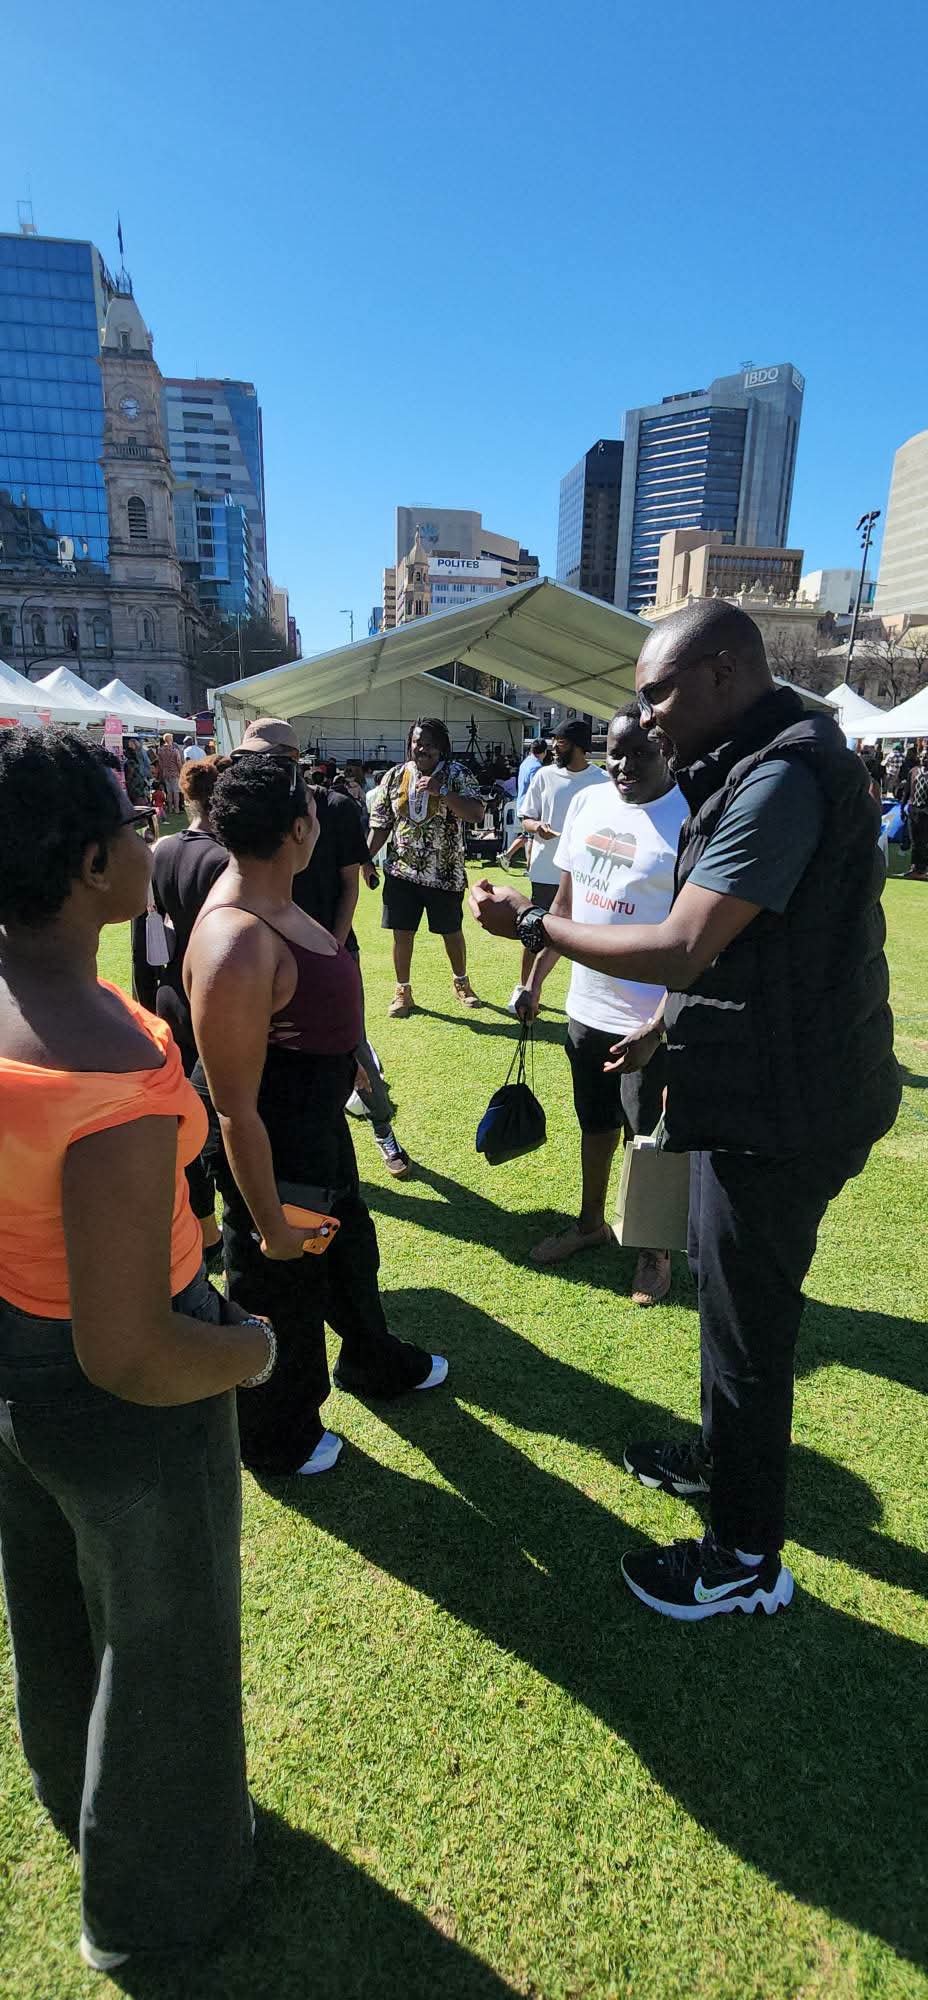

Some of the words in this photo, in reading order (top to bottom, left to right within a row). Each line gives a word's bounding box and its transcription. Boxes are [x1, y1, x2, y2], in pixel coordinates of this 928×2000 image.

[749, 368, 778, 384] BDO
[437, 559, 480, 569] POLITES
[585, 891, 636, 916] UBUNTU
